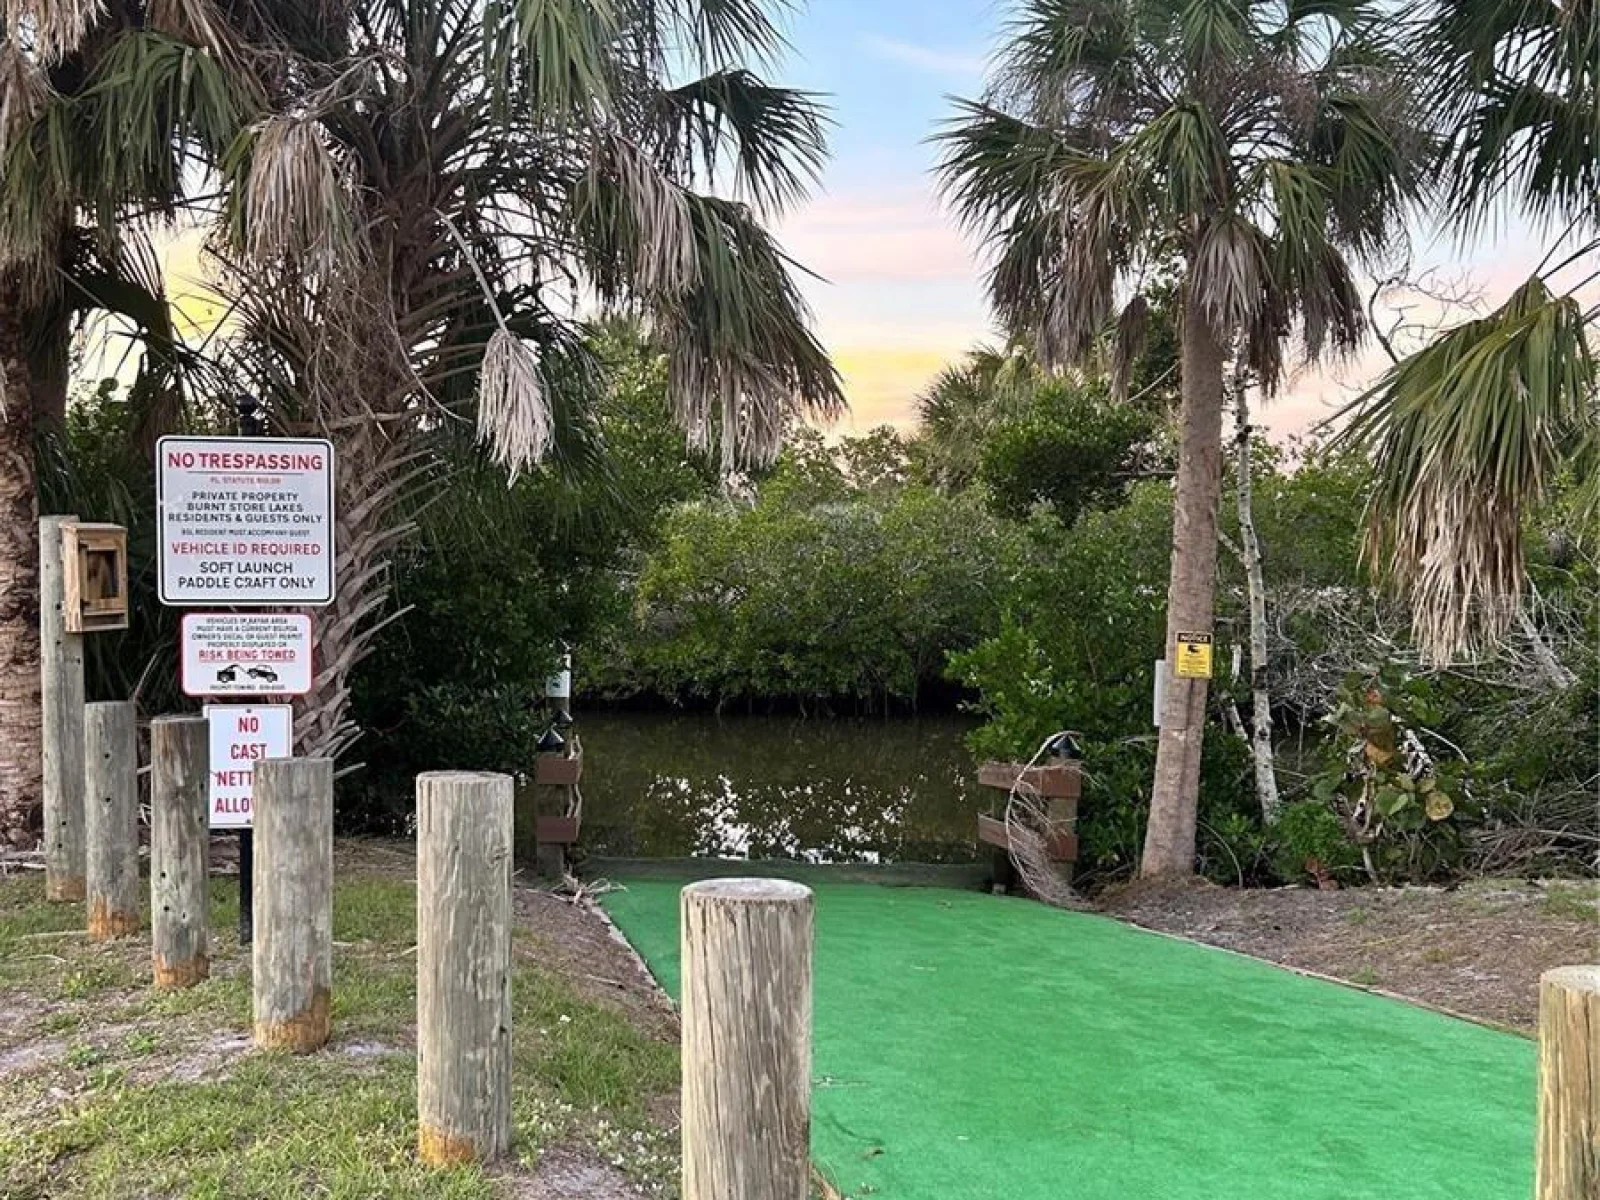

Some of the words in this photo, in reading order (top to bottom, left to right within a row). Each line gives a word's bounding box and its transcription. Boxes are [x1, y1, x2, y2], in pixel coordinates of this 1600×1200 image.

[168, 452, 195, 468] NO
[199, 452, 323, 470] TRESPASSING
[191, 491, 238, 501] PRIVATE
[241, 491, 300, 502] PROPERTY
[186, 502, 226, 512] BURNT
[229, 503, 266, 513] STORE
[269, 504, 304, 513] LAKES
[168, 513, 232, 523] RESIDENTS
[235, 515, 243, 523] &
[245, 514, 290, 523] GUESTS
[292, 514, 323, 524] ONLY
[229, 528, 247, 536] MUST
[248, 528, 288, 536] ACCOMPANY
[171, 542, 229, 555] VEHICLE
[232, 543, 248, 555] ID
[251, 543, 321, 556] REQUIRED
[200, 561, 234, 574] SOFT
[237, 561, 294, 574] LAUNCH
[178, 576, 230, 588] PADDLE
[234, 576, 276, 589] CRAFT
[279, 577, 316, 589] ONLY
[271, 617, 288, 625] AREA
[198, 649, 223, 660] RISK
[227, 649, 257, 660] BEING
[262, 649, 296, 660] TOWED
[237, 717, 259, 733] NO
[230, 743, 268, 760] CAST
[216, 771, 253, 787] NETT
